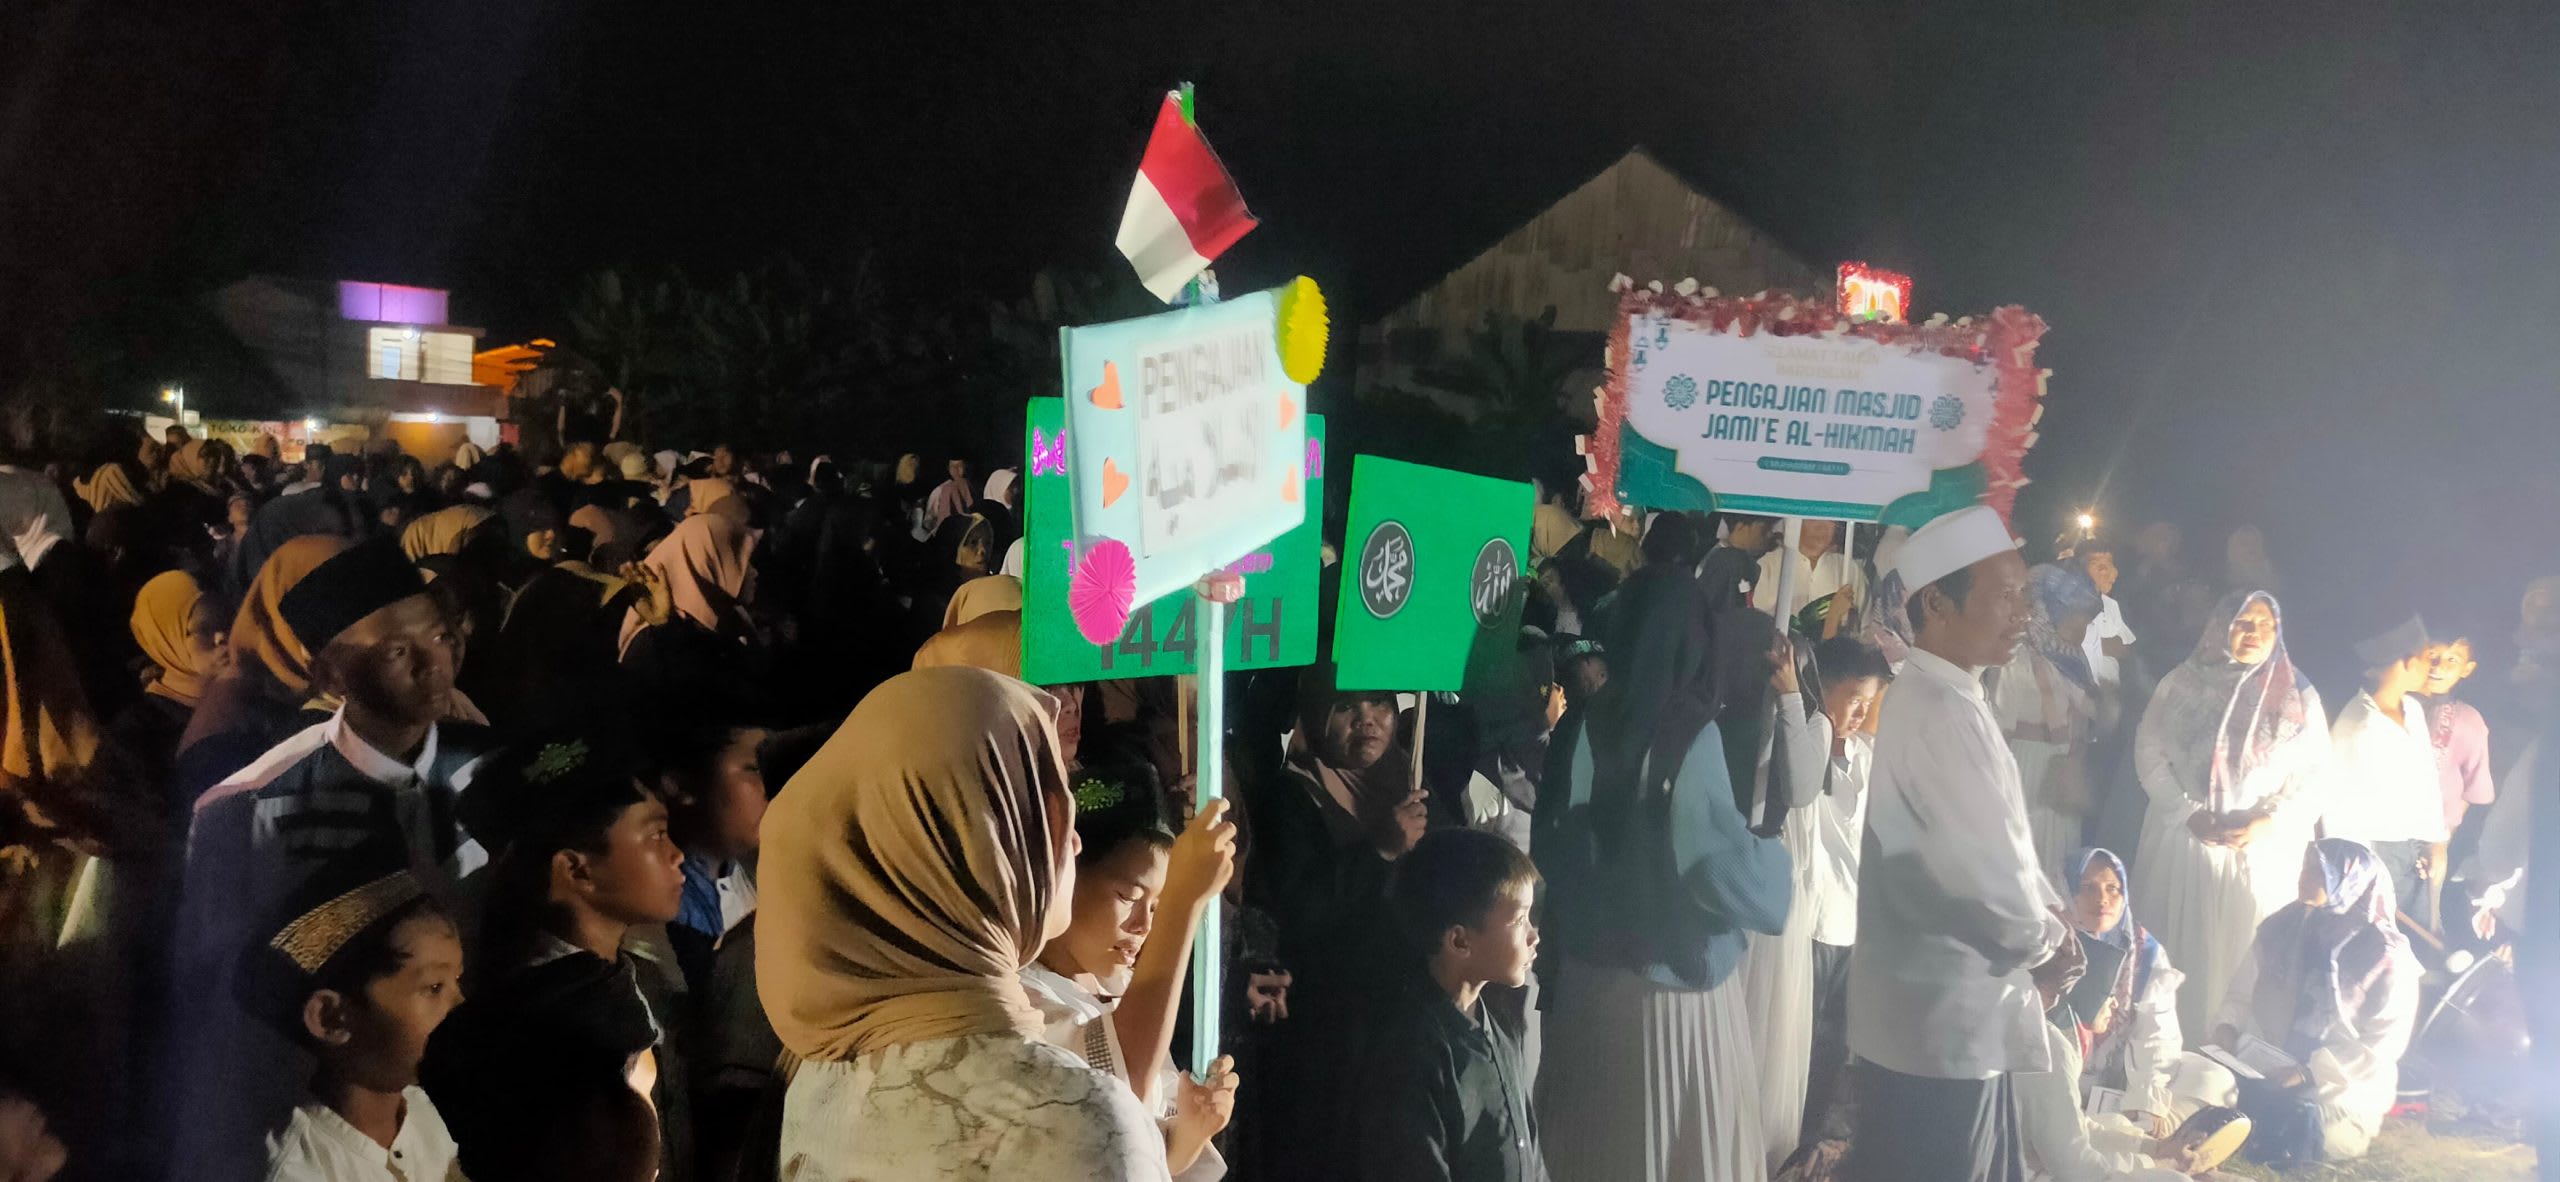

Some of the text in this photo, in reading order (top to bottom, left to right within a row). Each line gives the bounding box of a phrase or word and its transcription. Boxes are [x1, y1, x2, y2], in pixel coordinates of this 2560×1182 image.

[1142, 331, 1265, 419] PENGAJIAN
[1705, 379, 1922, 421] PENGAJIAN MASJID
[1701, 413, 1917, 454] JAMI'E AL-HIKMAH
